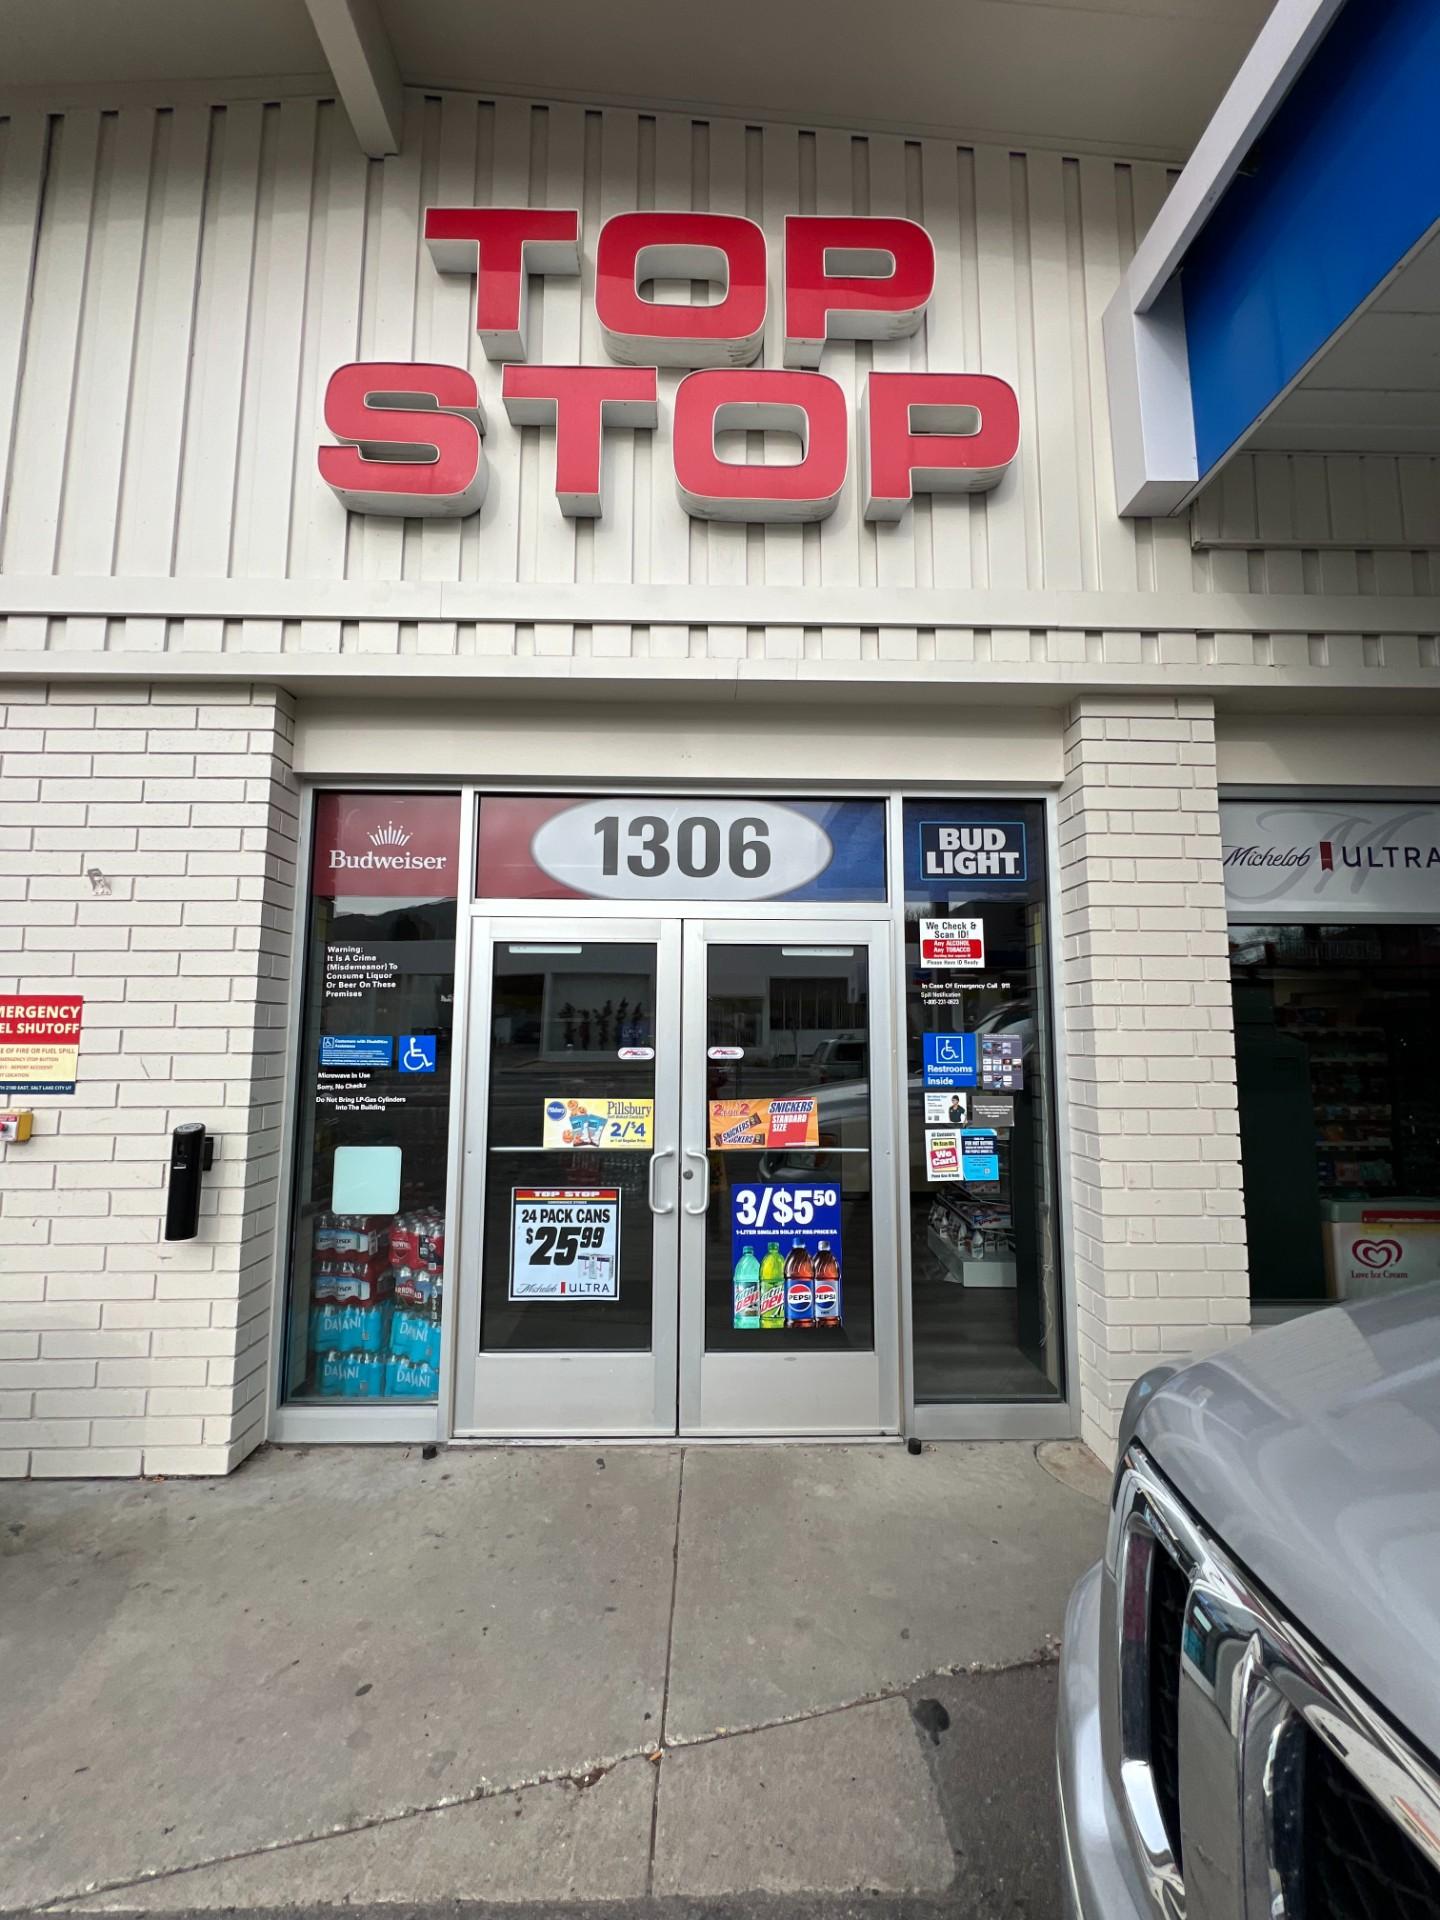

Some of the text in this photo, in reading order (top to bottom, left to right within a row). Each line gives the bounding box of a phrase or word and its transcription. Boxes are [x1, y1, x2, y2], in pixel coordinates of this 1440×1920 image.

[425, 207, 937, 345] TOP
[317, 362, 1020, 502] STOP
[939, 828, 1006, 851] BUD
[594, 816, 771, 878] 1306
[329, 850, 447, 869] Budweiser
[1221, 846, 1313, 867] Michelob
[926, 851, 1020, 875] LIGHT
[926, 922, 977, 930] We Check &
[327, 946, 363, 954] Warning:
[366, 972, 393, 981] Liquor
[17, 1023, 79, 1034] SHUTOFF
[927, 1065, 973, 1073] Restrooms
[927, 1077, 954, 1085] Inside
[608, 1101, 652, 1117] Pillsbury
[769, 1101, 814, 1113] SNICKERS
[772, 1115, 807, 1123] STANDARD
[772, 1124, 787, 1132] SIZE
[935, 1150, 953, 1159] We
[932, 1156, 957, 1166] Card
[522, 1209, 611, 1223] 24 PACK CANS
[1371, 1270, 1381, 1278] Ice
[1383, 1270, 1408, 1278] Cream
[569, 1283, 610, 1293] ULTRA
[324, 1364, 359, 1380] DASANI
[397, 1369, 431, 1387] DASANI
